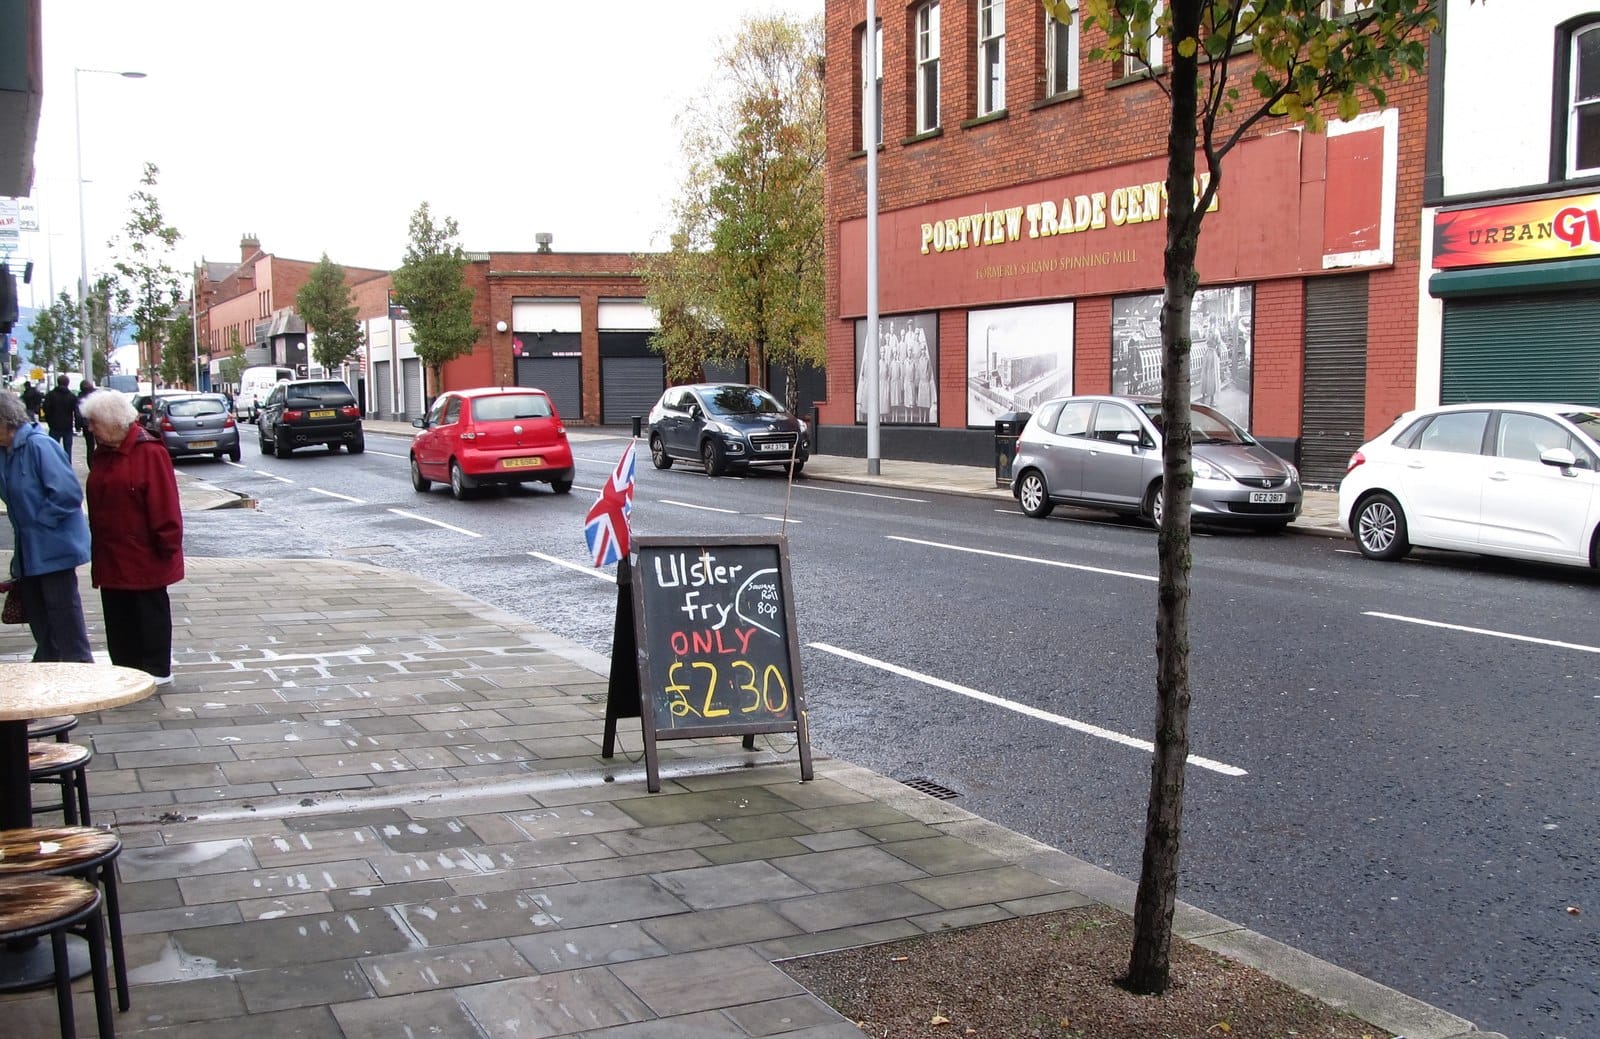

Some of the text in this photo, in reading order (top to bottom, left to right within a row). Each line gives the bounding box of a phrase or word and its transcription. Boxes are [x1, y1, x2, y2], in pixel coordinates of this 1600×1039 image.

[920, 206, 1024, 254] PORTVIEW
[1026, 192, 1107, 239] TRADE
[1468, 222, 1553, 246] URBAN
[976, 248, 1137, 280] FORMERLY STRAND SPINNING MILL
[654, 551, 743, 588] Ulster
[761, 590, 779, 601] Roll
[757, 601, 778, 620] 80p
[671, 627, 758, 656] ONLY
